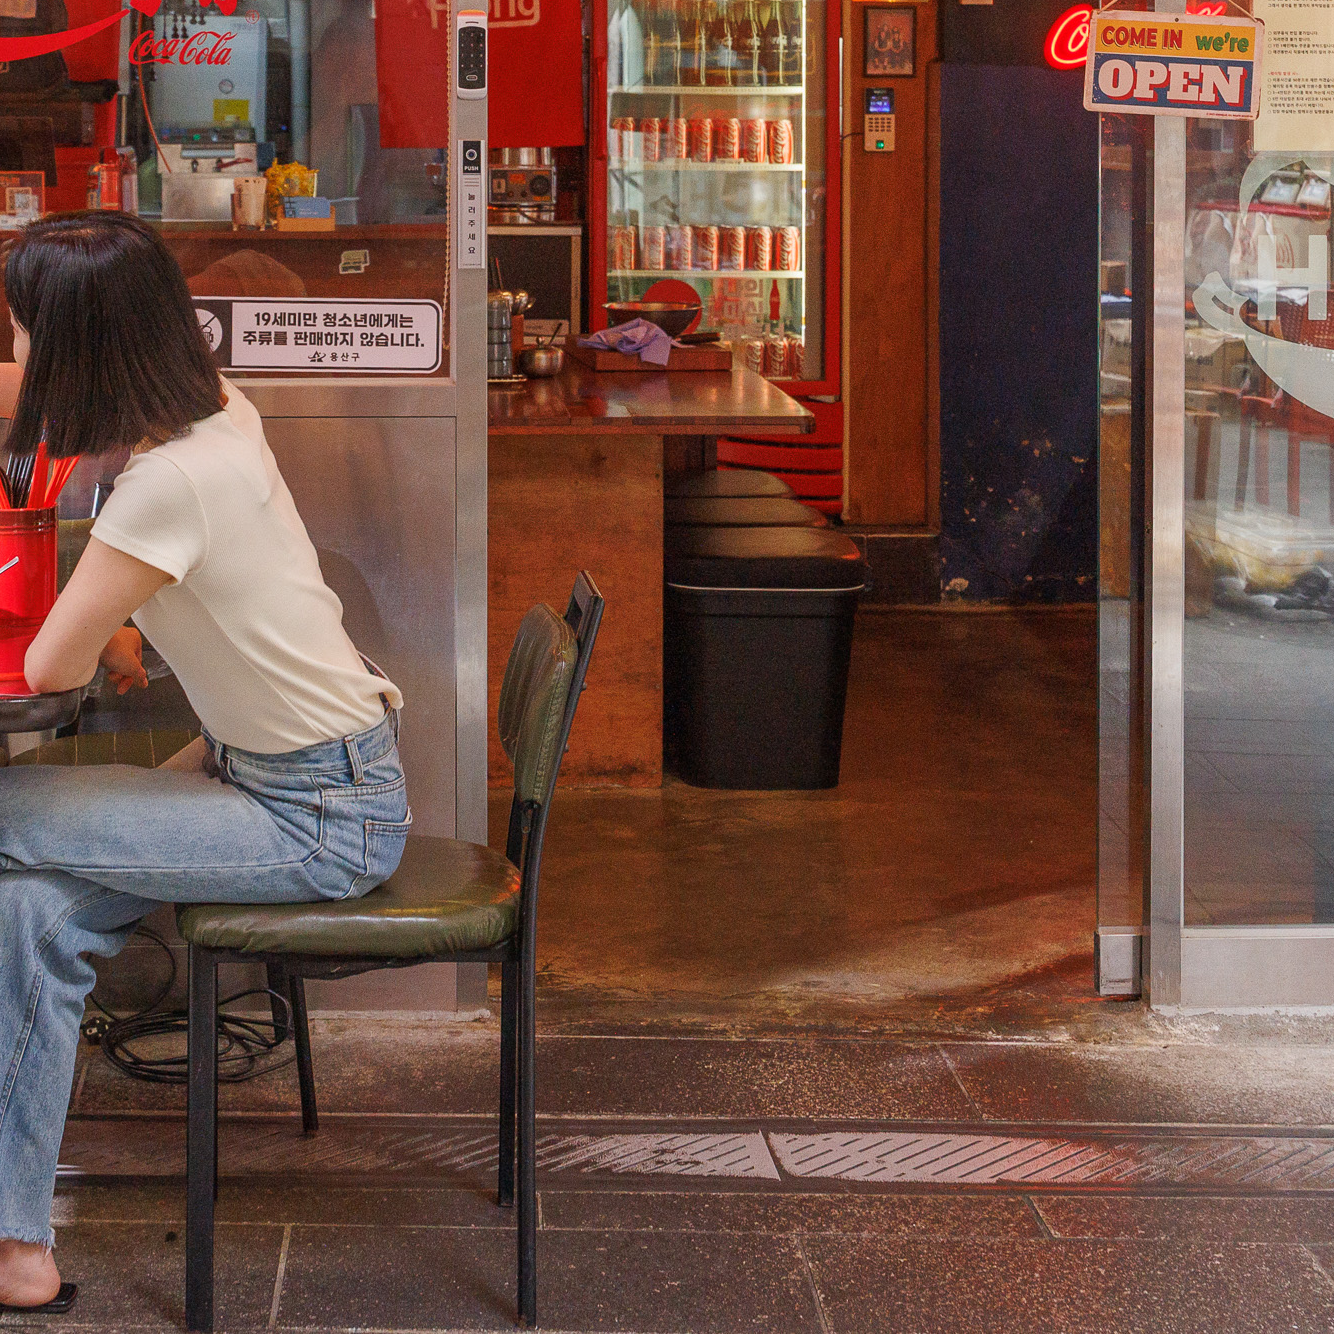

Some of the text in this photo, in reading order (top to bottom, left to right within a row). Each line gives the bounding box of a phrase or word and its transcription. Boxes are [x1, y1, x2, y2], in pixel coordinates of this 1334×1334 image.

[128, 30, 238, 66] Coca-Cola
[1101, 25, 1158, 49] COME
[1162, 28, 1184, 50] IN
[1195, 33, 1249, 53] we're
[1097, 59, 1248, 107] OPEN
[254, 312, 413, 328] 19세미만 청소년에게는
[242, 331, 425, 348] 주류를 판매하지 않습니다.
[329, 352, 360, 362] 용산구
